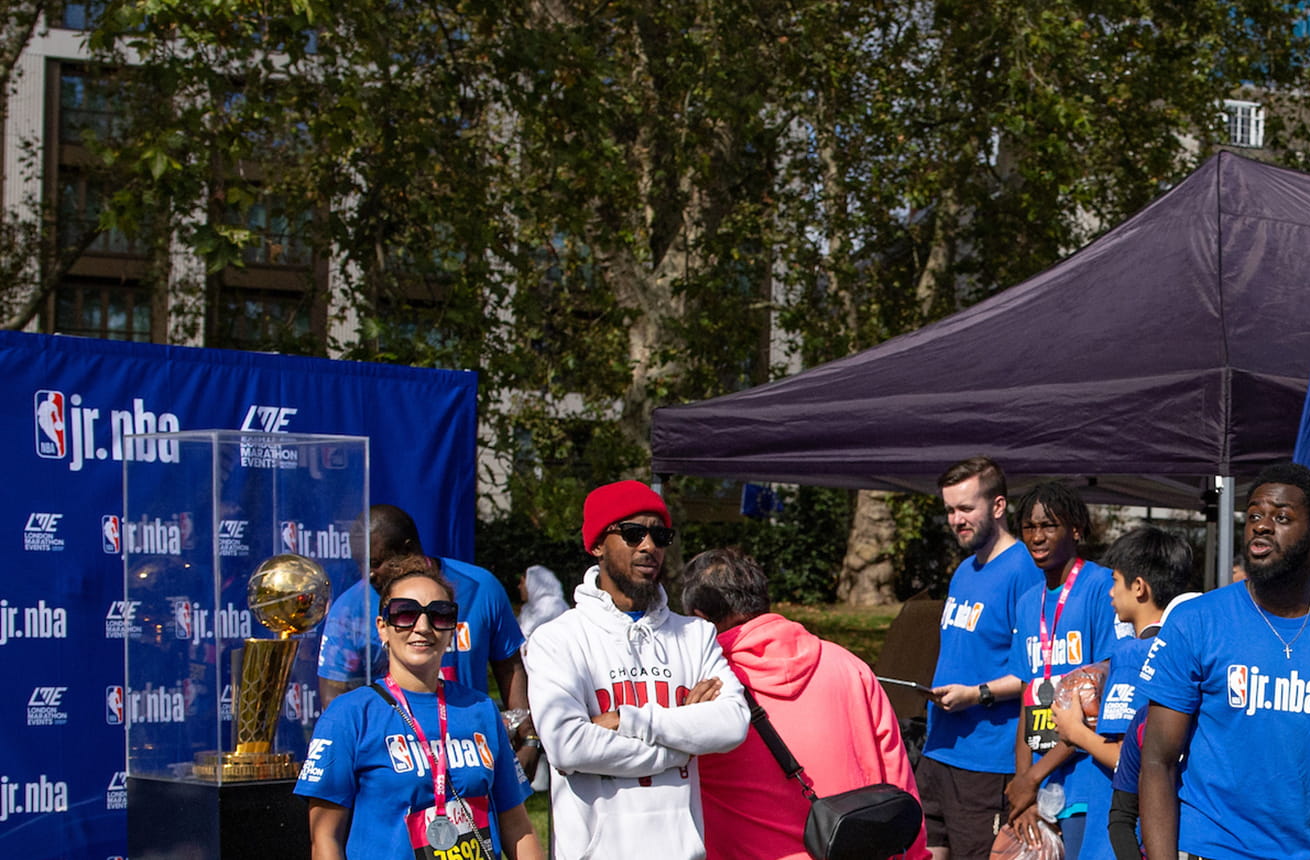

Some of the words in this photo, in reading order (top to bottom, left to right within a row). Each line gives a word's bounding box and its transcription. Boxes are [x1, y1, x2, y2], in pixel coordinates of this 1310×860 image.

[69, 393, 180, 472] jr.nba
[240, 448, 298, 461] MARATHON
[240, 457, 276, 469] EVENTS
[25, 512, 63, 532] LME
[298, 522, 351, 560] jr.nba
[0, 599, 67, 646] jr.nba
[192, 602, 251, 645] jr.nba
[28, 687, 68, 706] LME
[0, 774, 68, 821] jr.nba
